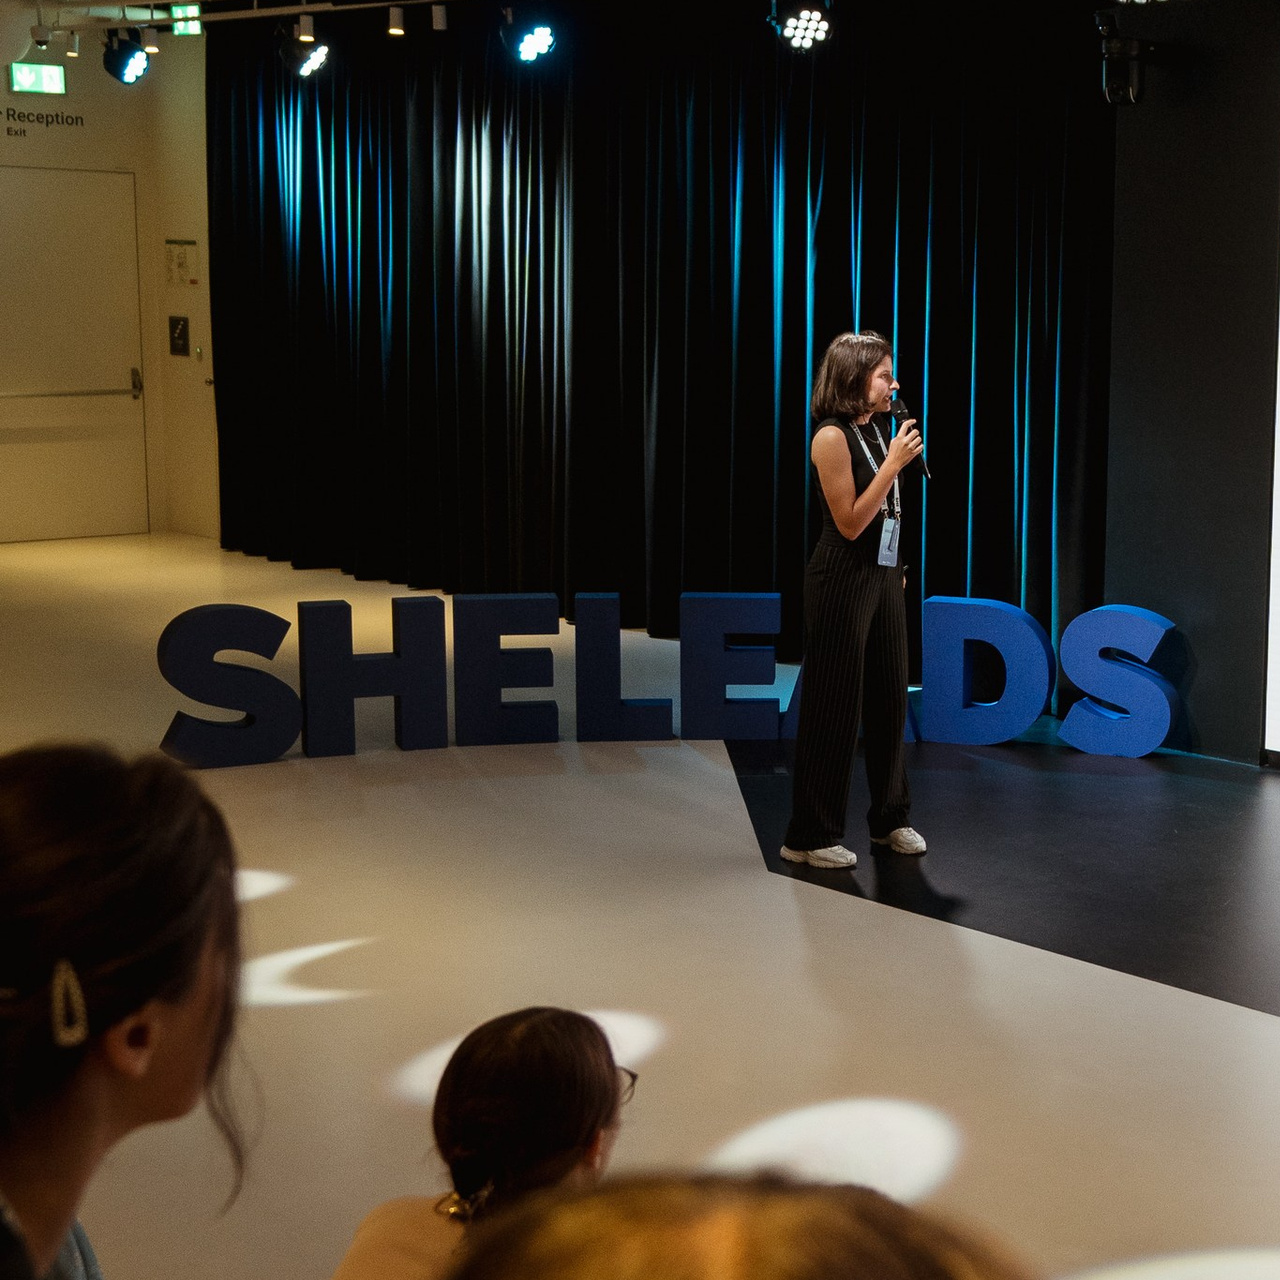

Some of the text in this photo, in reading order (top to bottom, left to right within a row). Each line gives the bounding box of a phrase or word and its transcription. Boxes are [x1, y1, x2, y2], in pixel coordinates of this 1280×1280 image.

[6, 108, 84, 127] Reception
[6, 127, 27, 137] Exit
[157, 592, 1180, 770] SHELEDS
